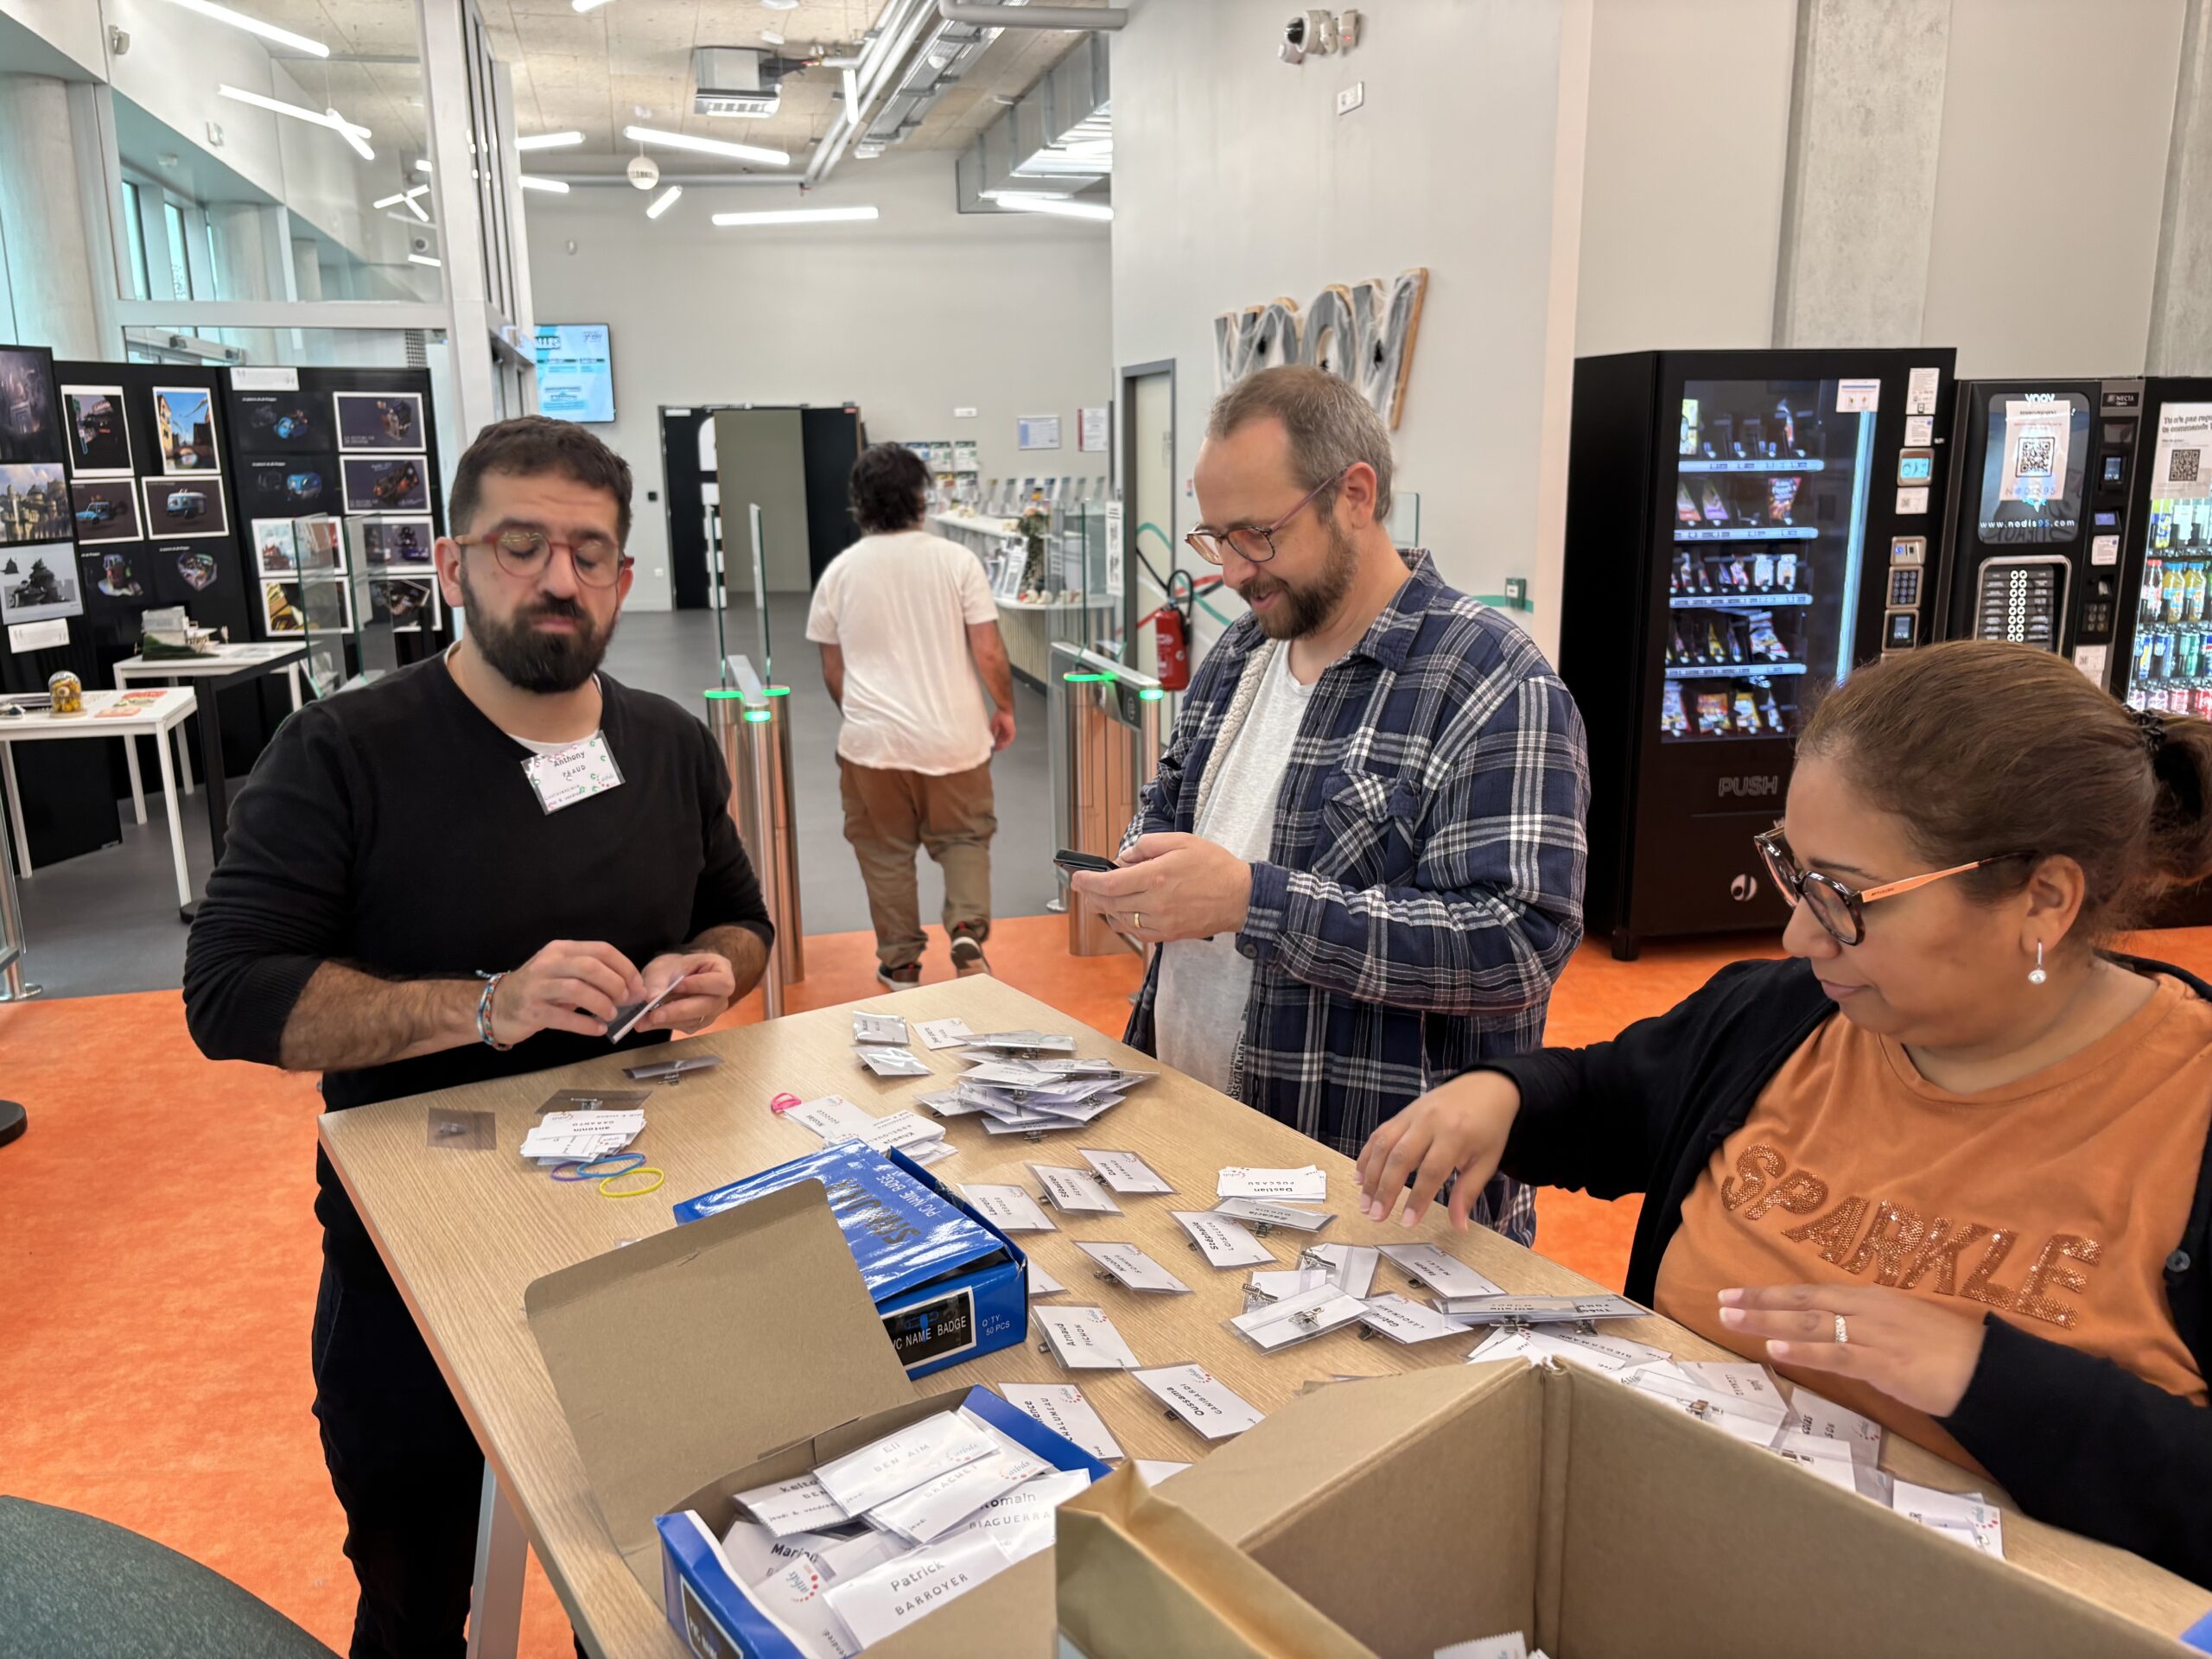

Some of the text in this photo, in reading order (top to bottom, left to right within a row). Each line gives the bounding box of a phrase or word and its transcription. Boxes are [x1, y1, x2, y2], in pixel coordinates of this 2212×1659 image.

[1980, 518, 2075, 529] www.nodis95.com
[554, 751, 585, 767] Anthony
[1719, 776, 1777, 797] PUSH
[1099, 1162, 1116, 1178] David
[875, 1173, 942, 1217] PVC NAME BADGE
[1048, 1174, 1071, 1198] Sébastien
[978, 1198, 998, 1216] Laurent
[1192, 1222, 1219, 1251] Stéphanie
[1721, 1142, 2103, 1331] SPARKLE
[906, 1328, 931, 1347] NAME
[938, 1316, 967, 1336] BADGE
[986, 1321, 1010, 1336] 50 PCS
[1054, 1323, 1076, 1346] Arnaud
[1074, 1324, 1093, 1346] PICHON
[1166, 1386, 1205, 1416] Oussama
[1041, 1397, 1073, 1441] CHALUMEAU
[874, 1444, 930, 1472] BEN AIM
[890, 1559, 945, 1592] Patrick
[895, 1573, 969, 1615] BARROYER
